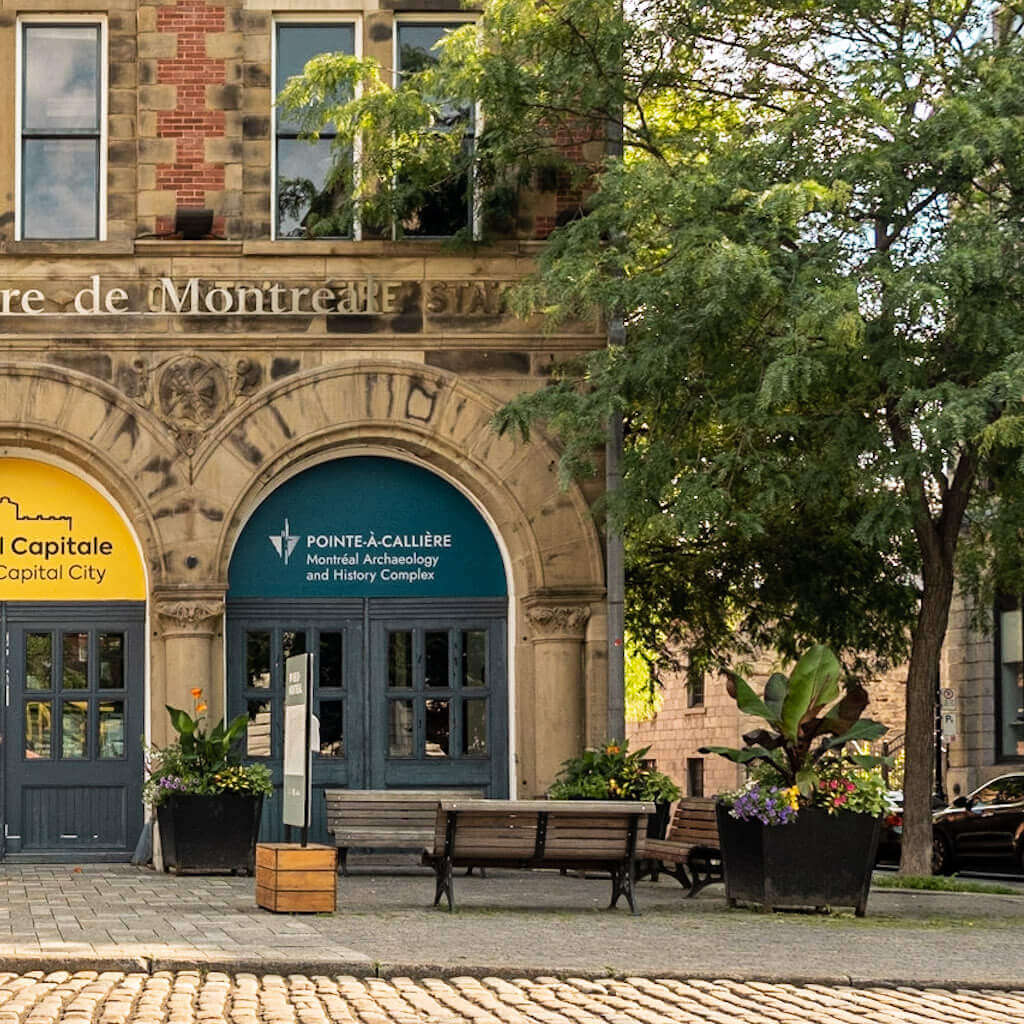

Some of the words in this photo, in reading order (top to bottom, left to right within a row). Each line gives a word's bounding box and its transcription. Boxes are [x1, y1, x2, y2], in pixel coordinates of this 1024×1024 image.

[74, 275, 129, 314] de
[160, 275, 383, 315] Montréal
[11, 536, 113, 560] Capitale
[307, 531, 452, 548] POINTE-À-CALLIÈRE
[306, 553, 359, 566] Montréal
[363, 553, 439, 567] Archaeology
[68, 564, 106, 584] City
[306, 569, 329, 581] and
[333, 569, 376, 583] History
[380, 568, 435, 583] Complex
